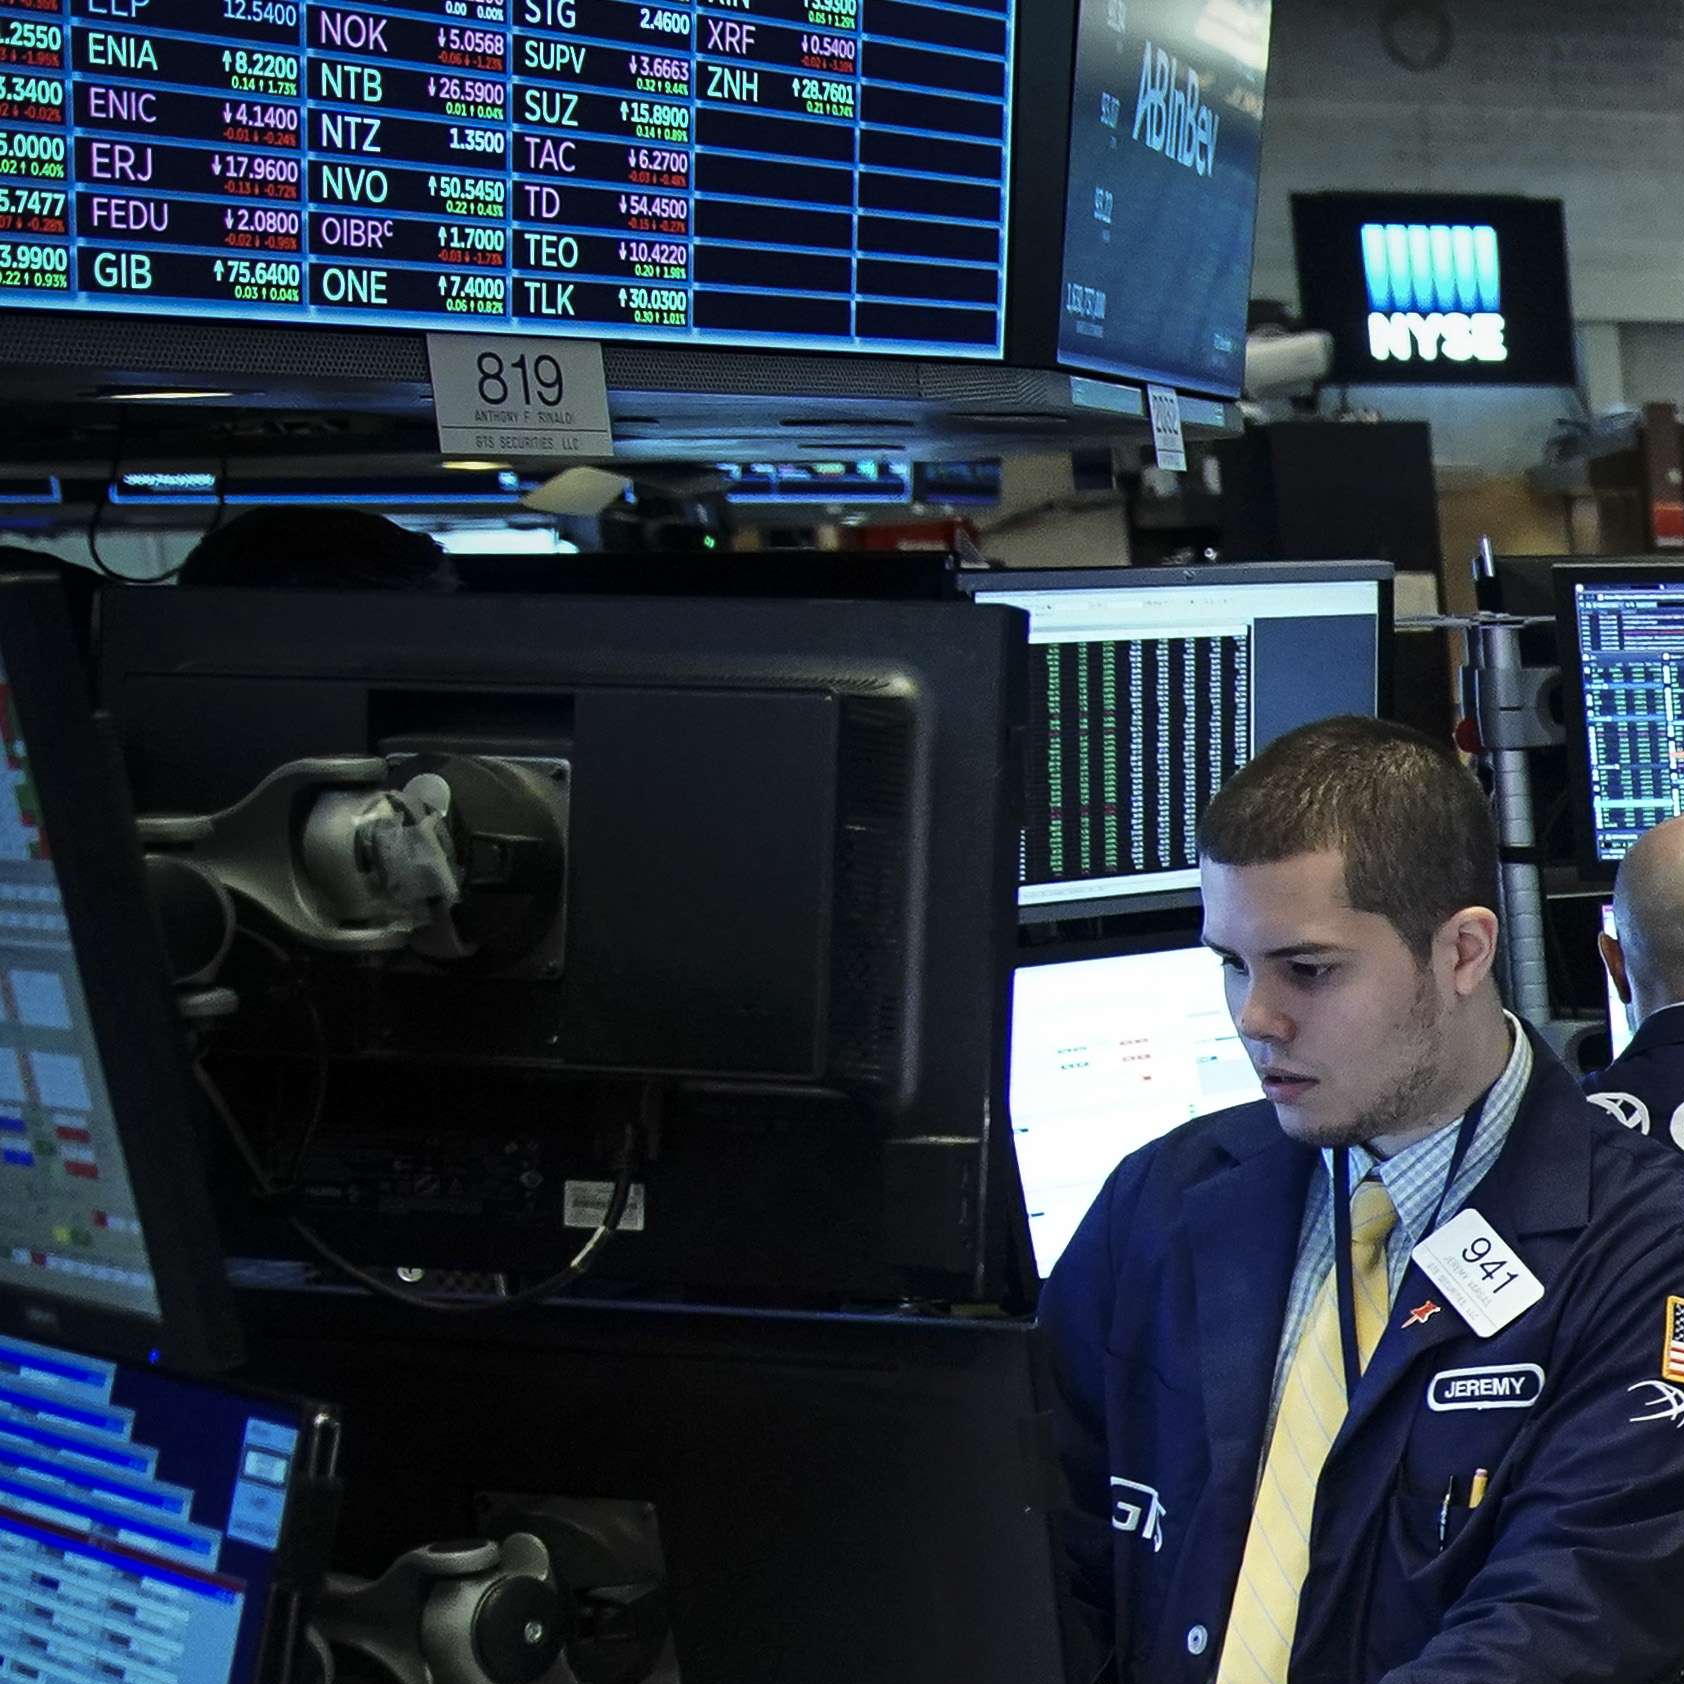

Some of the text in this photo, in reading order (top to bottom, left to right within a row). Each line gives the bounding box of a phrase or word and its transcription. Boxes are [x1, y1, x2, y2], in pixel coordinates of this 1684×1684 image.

[224, 0, 296, 26] 12.5400
[640, 8, 689, 34] 2.4600
[0, 22, 61, 52] .2550
[321, 11, 504, 58] NOK 5.0568
[708, 19, 855, 61] XRF 0.5400
[89, 33, 297, 82] ENIA 8.2200
[525, 40, 688, 83] SUPV 3.6663
[322, 63, 504, 107] NTB 26.5900
[707, 66, 854, 106] ZNH 28.7601
[90, 87, 297, 133] ENIC 4.1400
[525, 90, 688, 131] SUZ 15.8900
[322, 114, 504, 153] NTZ 1.3500
[92, 143, 298, 182] ERJ 17.9600
[525, 137, 687, 173] TAC 6.2700
[323, 165, 504, 204] NVO 50.5450
[525, 185, 687, 219] TD 54.4500
[93, 198, 298, 234] FEDU 2.0800
[450, 227, 504, 251] 1.7000
[524, 233, 686, 267] TEO 10.4220
[94, 253, 299, 289] GIB 75.6400
[323, 268, 504, 304] ONE 7.4000
[524, 281, 686, 315] TLK 30.0300
[1367, 311, 1507, 361] NYSE
[477, 352, 563, 407] 819
[1461, 1238, 1519, 1294] 941
[1444, 1376, 1526, 1398] JEREMY
